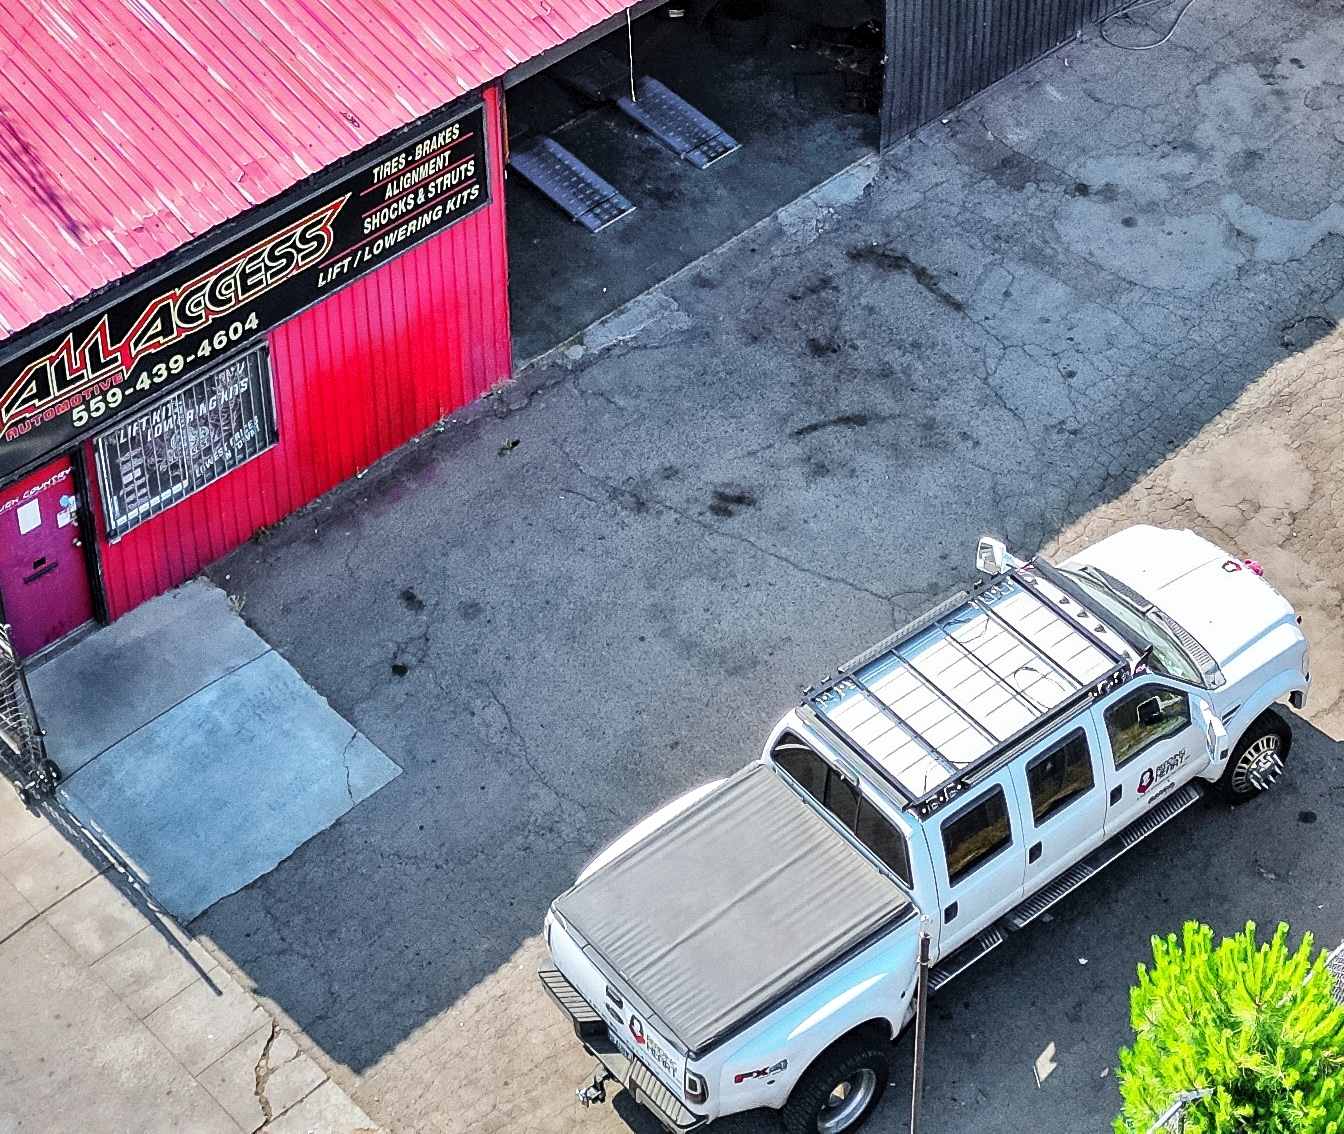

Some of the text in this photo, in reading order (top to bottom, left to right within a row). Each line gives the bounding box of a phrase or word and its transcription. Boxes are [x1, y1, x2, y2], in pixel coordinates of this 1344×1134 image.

[372, 153, 405, 184] TIRES
[414, 123, 461, 160] BRAKES
[385, 149, 451, 201] ALIGNMENT
[363, 159, 475, 235] SHOCKS & STRUTS
[317, 256, 352, 288] LIFT
[363, 205, 443, 262] LOWERING
[445, 184, 480, 215] KITS
[127, 194, 350, 364] ACCESS
[72, 311, 259, 427] 559-439-4604
[5, 371, 124, 442] AUTOMOTIVE
[22, 467, 72, 499] COUNTRY
[733, 1058, 788, 1084] FX4
